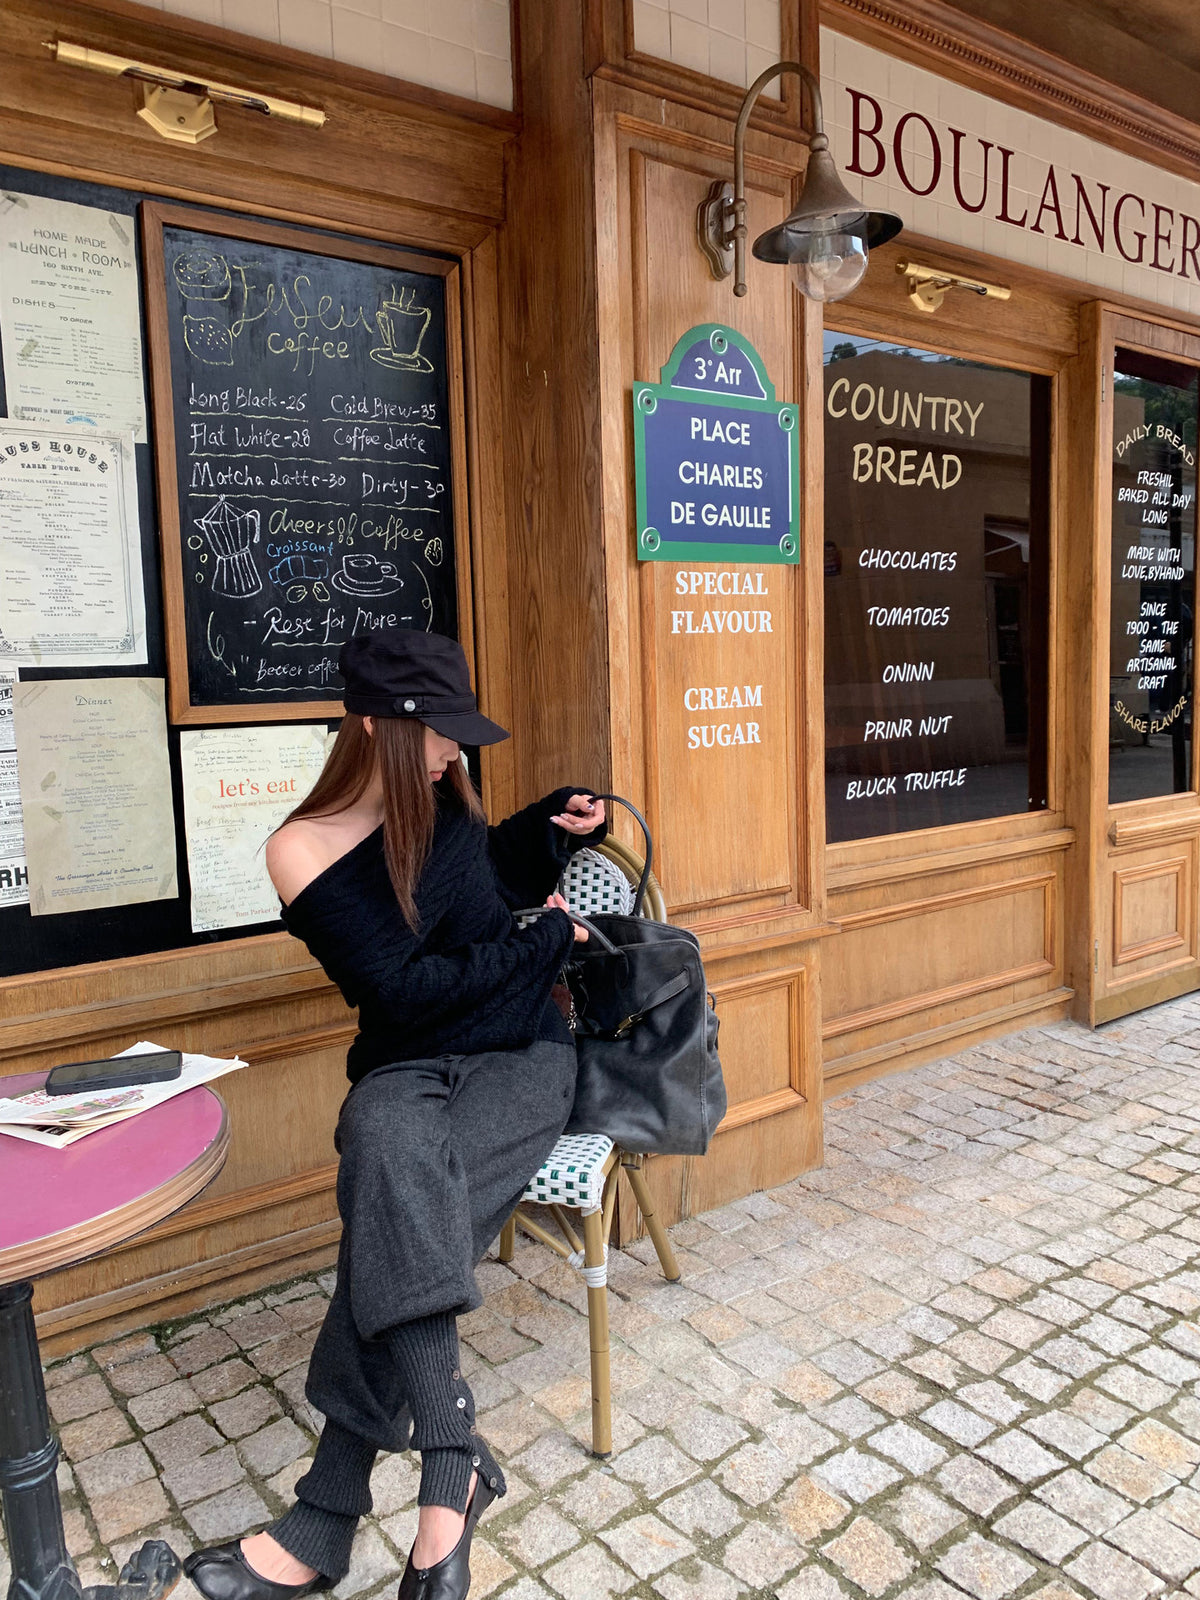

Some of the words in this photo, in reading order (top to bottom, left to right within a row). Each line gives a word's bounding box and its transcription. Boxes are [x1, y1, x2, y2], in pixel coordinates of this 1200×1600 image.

[845, 87, 1200, 281] BOULANGER
[33, 228, 68, 242] HOME
[74, 235, 107, 249] MADE
[20, 241, 67, 259] LUNCH
[82, 251, 121, 268] ROOM
[61, 264, 84, 273] SIXTH
[88, 269, 104, 277] AVE.
[31, 279, 57, 287] NEW
[60, 283, 87, 292] YORK
[12, 297, 56, 309] DISHES
[70, 317, 93, 325] ORDER
[65, 379, 95, 387] OYSTERS
[714, 361, 742, 386] Arr
[188, 382, 230, 412] Long
[330, 394, 369, 416] Cold
[827, 377, 984, 437] COUNTRY
[189, 422, 227, 455] Flat
[333, 427, 381, 452] Coffee
[383, 427, 427, 454] Latte
[690, 416, 751, 446] PLACE
[49, 441, 108, 473] HOUSE
[1115, 423, 1153, 458] DAILY
[1156, 425, 1195, 467] BREAD
[678, 460, 763, 490] CHARLES
[852, 442, 963, 490] BREAD
[1118, 487, 1149, 504] BAKED
[1152, 491, 1170, 506] ALL
[1172, 493, 1192, 510] DAY
[670, 501, 696, 525] DE
[701, 503, 771, 529] GAULLE
[1142, 508, 1168, 524] LONG
[360, 514, 425, 551] Coffee
[266, 540, 334, 557] Croissant
[858, 548, 958, 572] CHOCOLATES
[1127, 545, 1155, 561] MADE
[1157, 547, 1181, 562] WITH
[675, 570, 769, 596] SPECIAL
[866, 606, 950, 627] TOMATOES
[1140, 601, 1168, 617] SINCE
[321, 607, 346, 644] for
[671, 610, 773, 635] FLAVOUR
[1126, 620, 1150, 635] 1900
[1161, 620, 1180, 635] THE
[1139, 639, 1167, 653] SAME
[882, 661, 935, 684] ONINN
[1126, 656, 1177, 673] ARTISANAL
[1137, 674, 1168, 690] CRAFT
[75, 695, 112, 706] Dinner
[684, 685, 763, 712] CREAM
[1114, 700, 1148, 733] SHARE
[1150, 695, 1188, 734] FLAVOR
[687, 721, 761, 750] SUGAR
[863, 717, 913, 742] PRINR
[918, 715, 953, 737] NUT
[266, 777, 297, 793] eat
[845, 776, 897, 801] BLUCK
[904, 768, 968, 792] TRUFFLE
